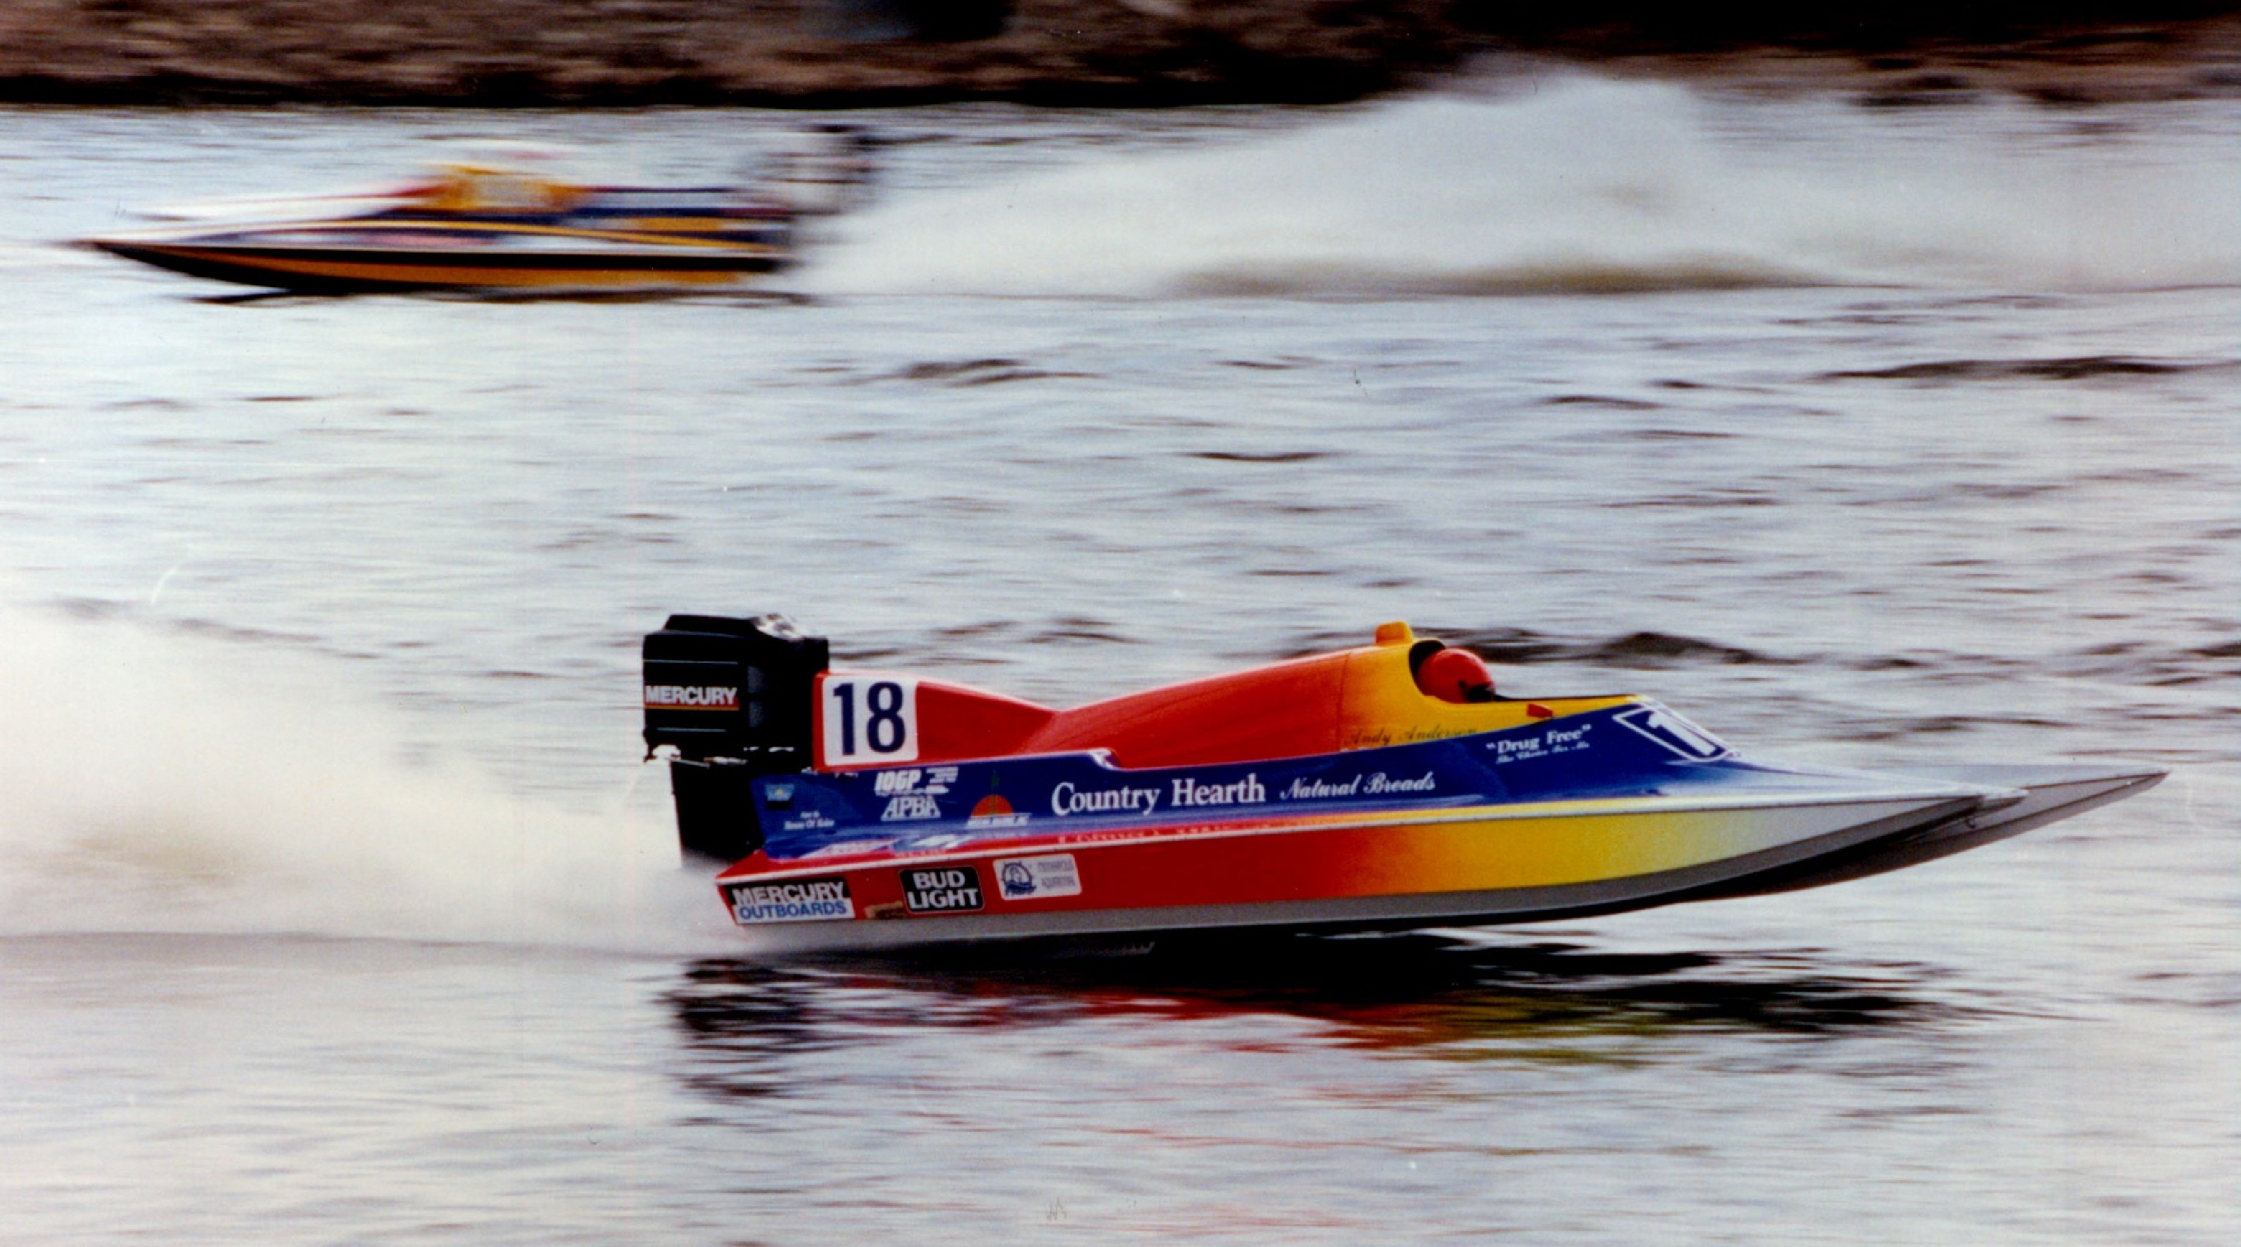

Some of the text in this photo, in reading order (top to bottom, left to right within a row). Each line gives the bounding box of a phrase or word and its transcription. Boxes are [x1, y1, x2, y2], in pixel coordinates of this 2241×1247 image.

[645, 685, 737, 704] MERCURY
[833, 681, 905, 756] 18
[1344, 728, 1391, 747] Andy
[1051, 771, 1435, 816] Country Hearth Natural Breads
[880, 796, 942, 822] APBA
[912, 870, 966, 890] BUD
[732, 881, 844, 906] MERCURY
[907, 888, 979, 909] LIGHT
[739, 901, 847, 919] OUTBOARDS
